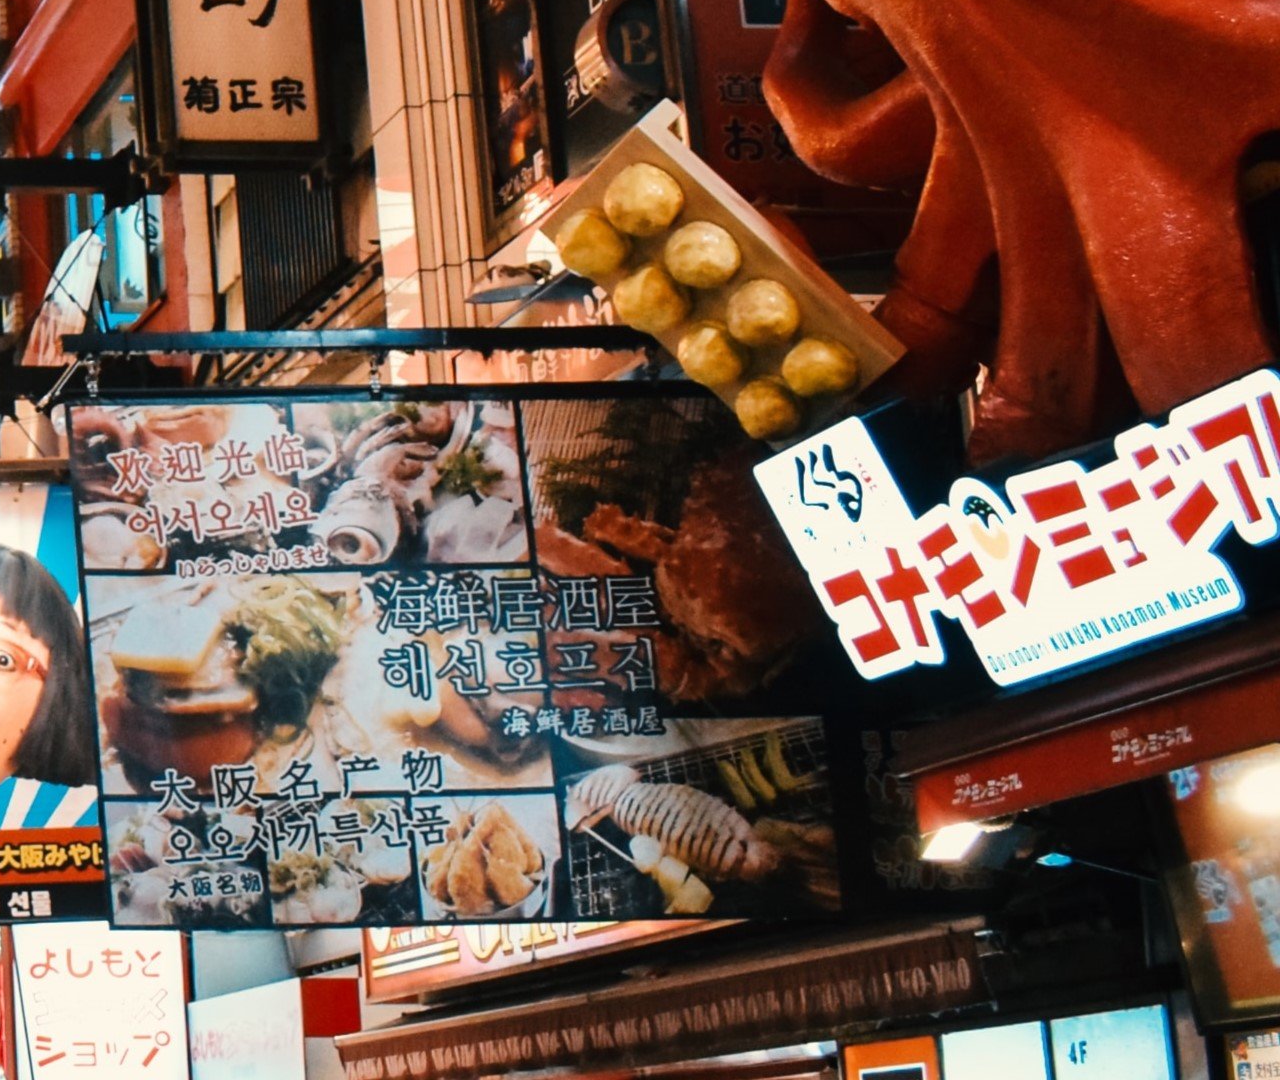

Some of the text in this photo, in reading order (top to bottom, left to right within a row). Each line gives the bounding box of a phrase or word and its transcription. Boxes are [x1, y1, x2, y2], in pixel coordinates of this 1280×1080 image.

[182, 77, 307, 116] 菊正宗
[111, 432, 307, 493] 欢迎光临
[127, 490, 319, 548] 어서오세요
[823, 392, 1280, 663] コナモンミュージア
[174, 543, 329, 581] いらっしゃいませ
[379, 636, 658, 701] 해선호프집
[164, 806, 451, 868] 오오사까특산품
[166, 870, 263, 901] 大阪名物
[31, 948, 162, 979] よしもと
[35, 1030, 171, 1068] ショップ
